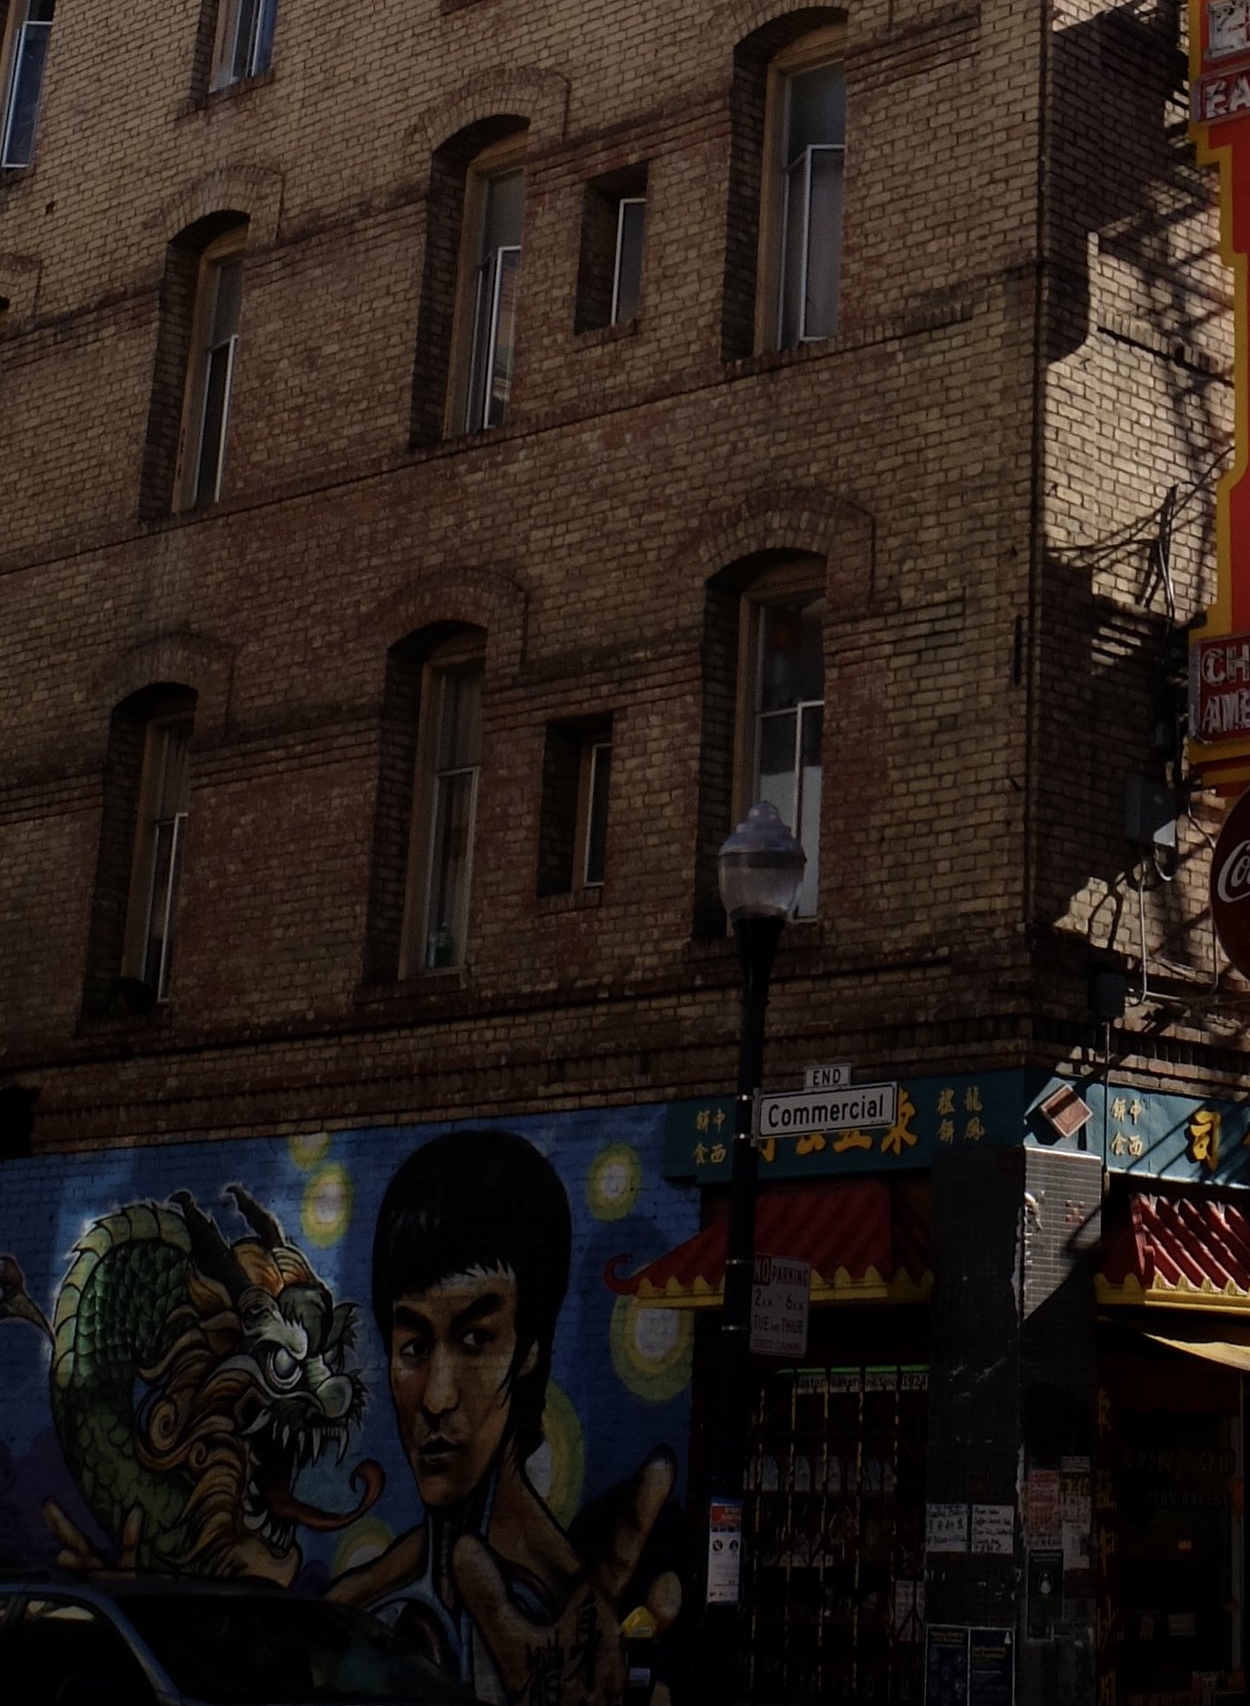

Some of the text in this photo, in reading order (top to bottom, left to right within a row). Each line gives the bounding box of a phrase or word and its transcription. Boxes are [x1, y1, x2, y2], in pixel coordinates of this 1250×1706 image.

[812, 1068, 842, 1086] END
[768, 1094, 884, 1128] Commercial
[754, 1257, 809, 1287] NO PARKING
[754, 1315, 769, 1332] TUE
[781, 1318, 804, 1335] THUR
